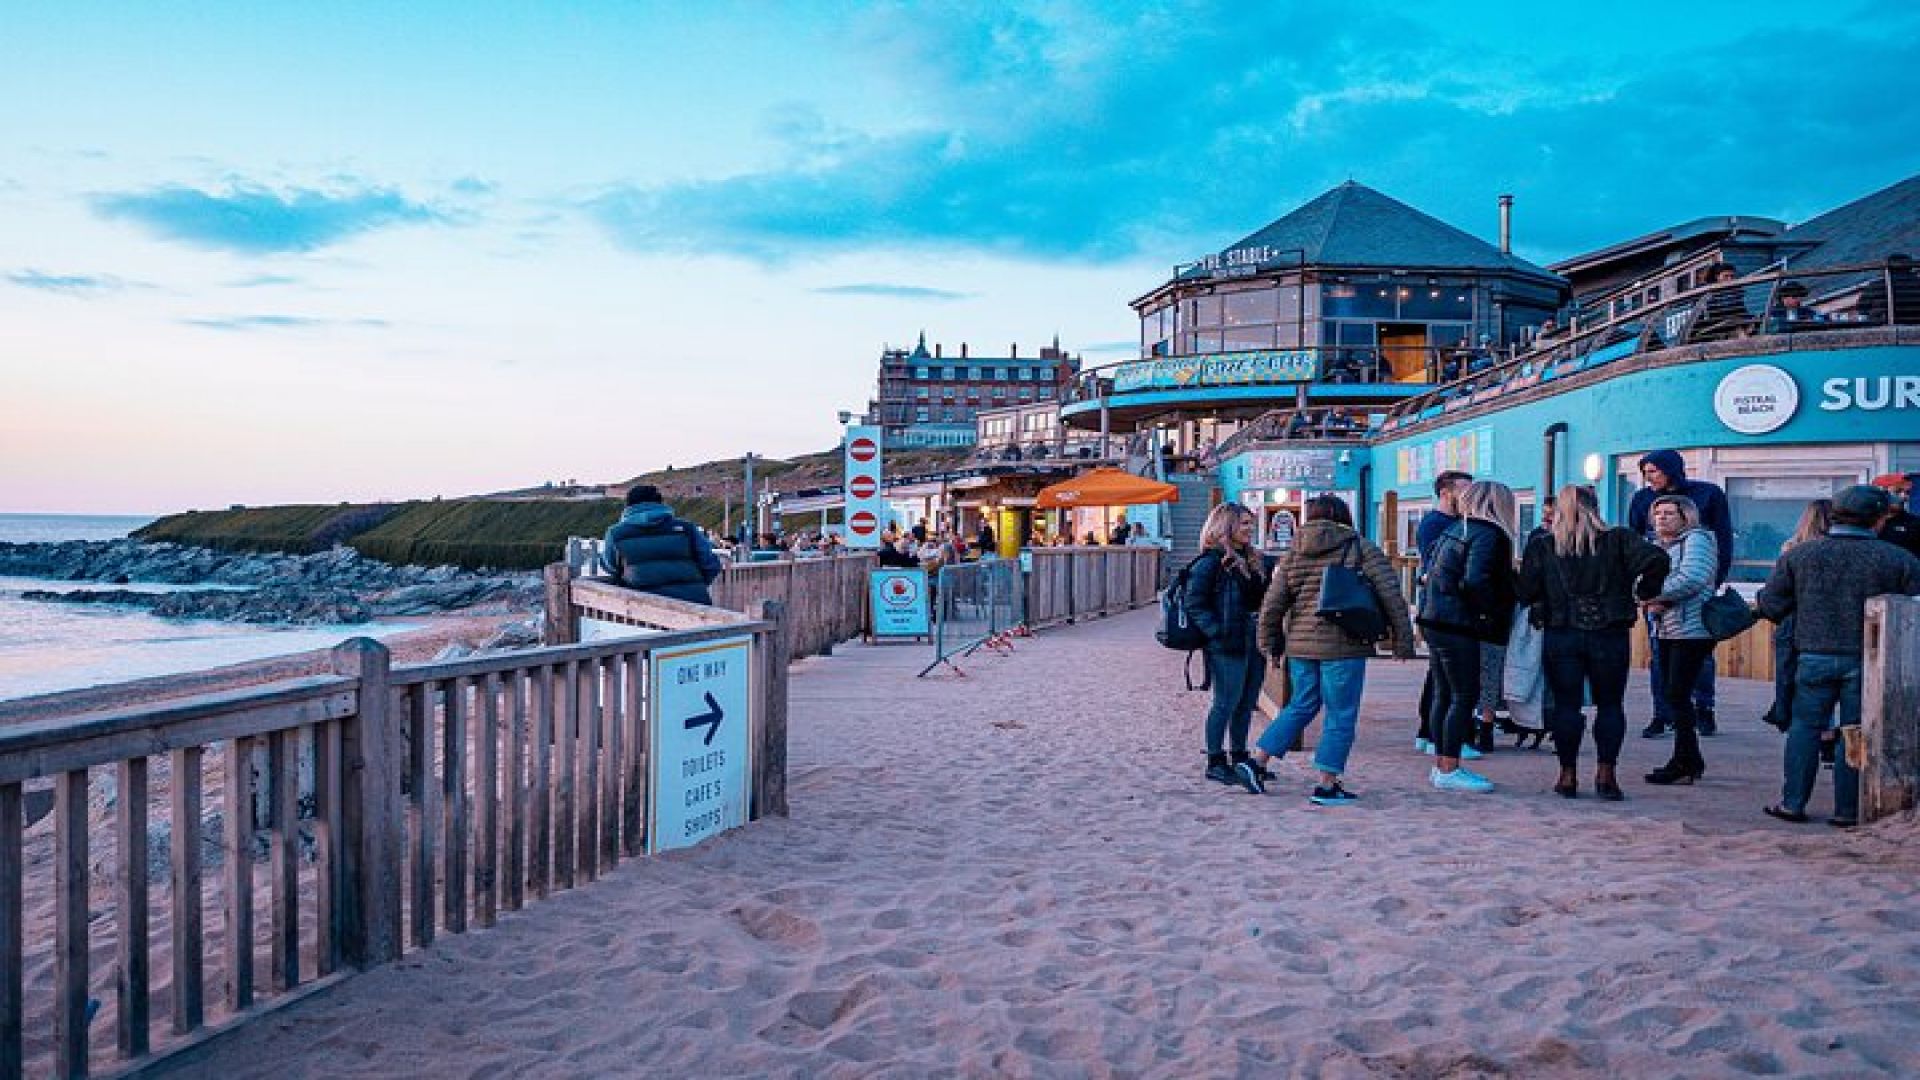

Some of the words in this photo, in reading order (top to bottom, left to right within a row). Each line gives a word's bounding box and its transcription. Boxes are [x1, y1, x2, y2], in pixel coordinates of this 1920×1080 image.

[1227, 245, 1270, 266] STABLE
[1820, 375, 1920, 410] SUR
[1738, 404, 1774, 415] BEACH
[677, 663, 699, 684] ONE
[704, 660, 727, 678] WAY
[682, 750, 725, 778] TOILETS
[685, 808, 721, 837] SHOPS
